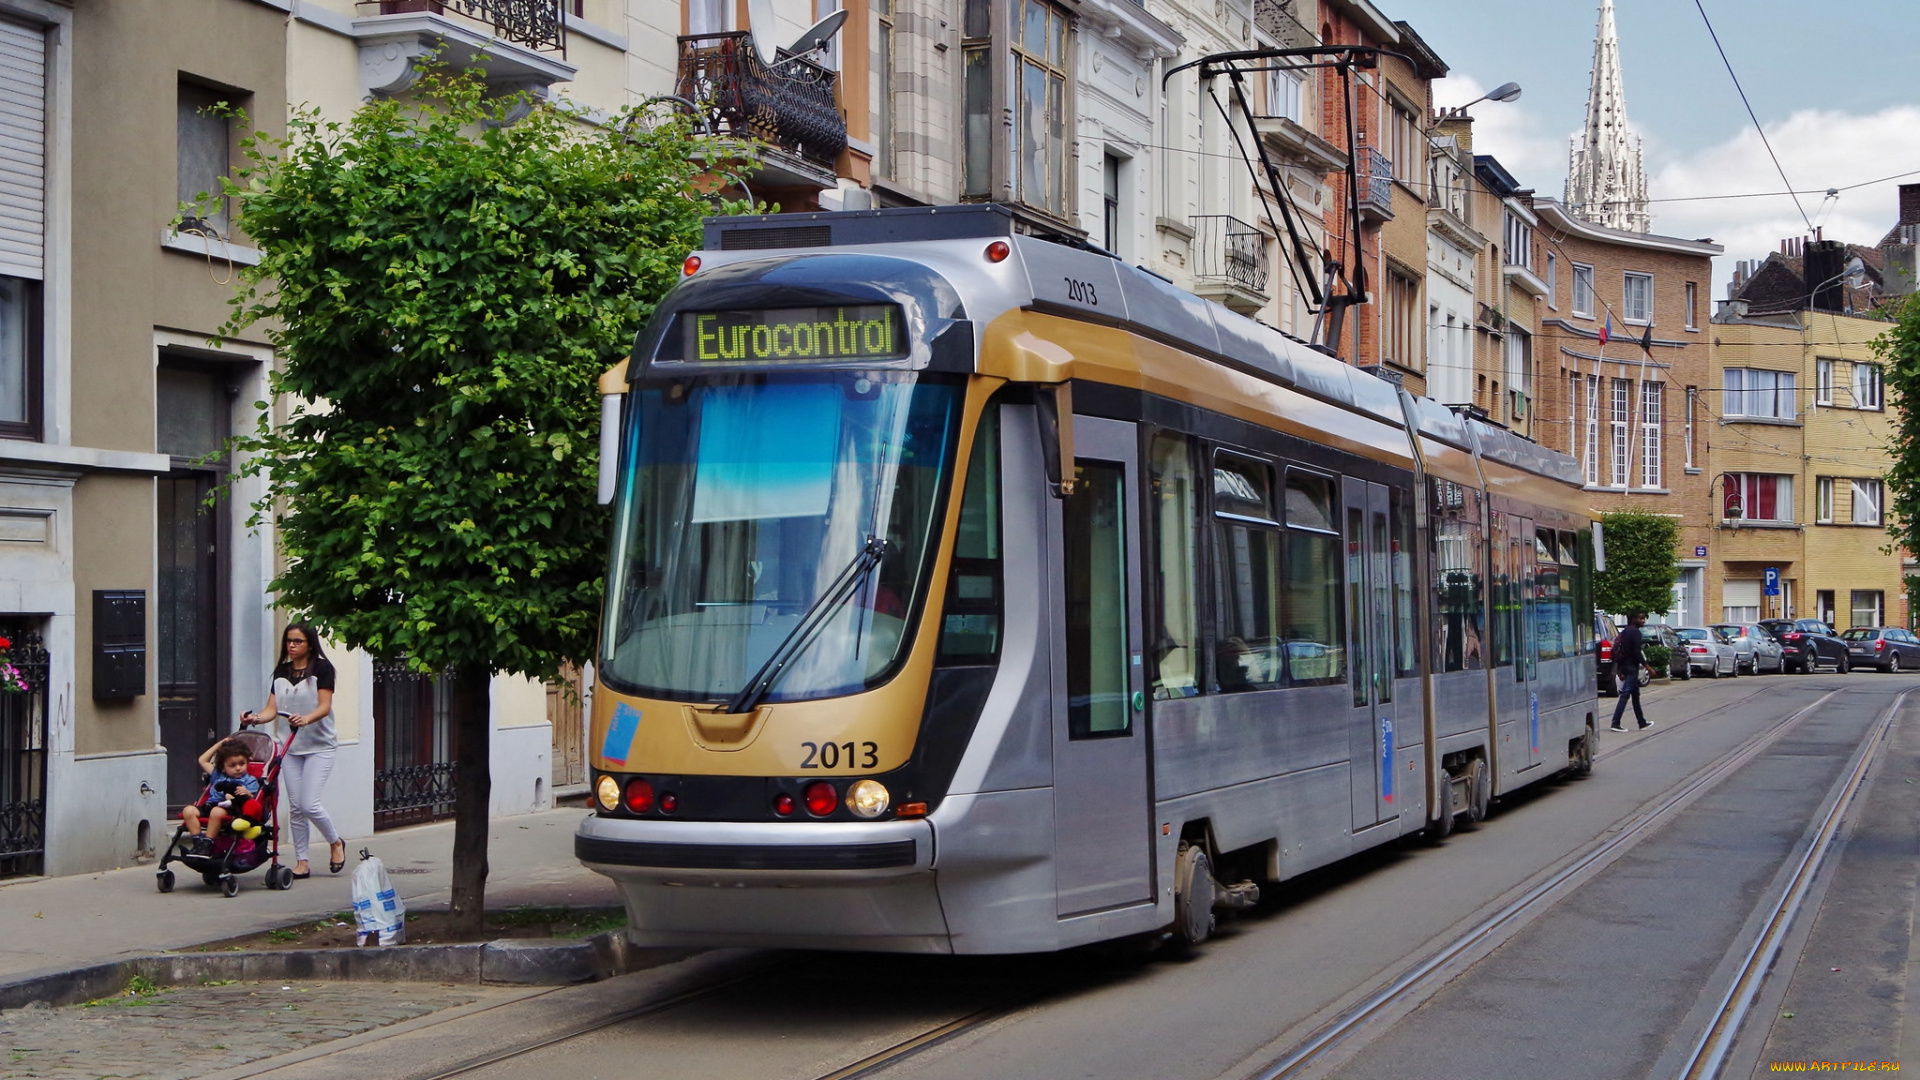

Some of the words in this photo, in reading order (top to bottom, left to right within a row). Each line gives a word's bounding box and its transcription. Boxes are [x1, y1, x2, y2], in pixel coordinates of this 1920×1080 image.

[1064, 277, 1097, 305] 2013
[697, 307, 892, 360] Eurocontrol
[1766, 571, 1776, 585] P
[800, 741, 879, 769] 2013
